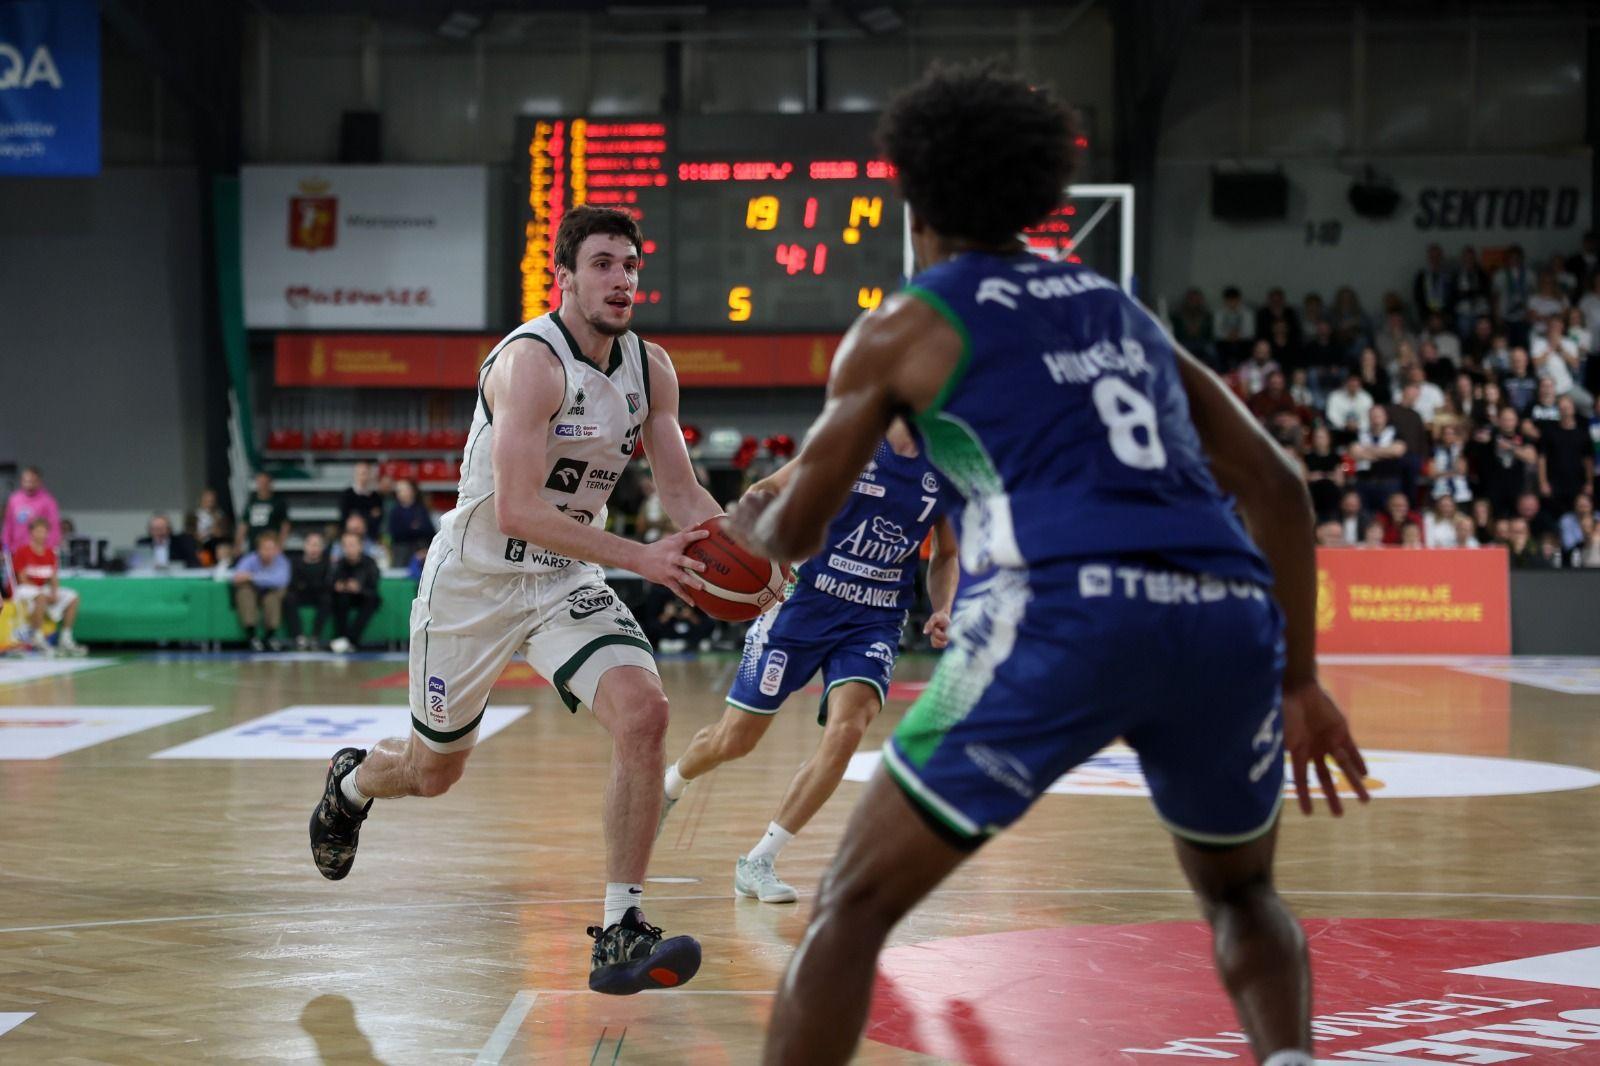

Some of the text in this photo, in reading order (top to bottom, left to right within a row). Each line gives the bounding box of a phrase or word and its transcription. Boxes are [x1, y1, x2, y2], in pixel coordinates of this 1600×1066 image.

[746, 195, 882, 230] 19 1 14
[1414, 187, 1580, 231] SEKTOR D
[728, 286, 752, 322] 5
[1092, 375, 1167, 470] 8
[589, 469, 618, 482] ORLE
[916, 495, 937, 522] 7
[834, 519, 920, 564] Anwil
[831, 558, 900, 580] GRUPA ORLEN
[815, 572, 900, 607] WŁOCŁAWEK
[1349, 585, 1451, 603] TRAMWAJE
[1350, 604, 1482, 621] WARSZAWSKIE
